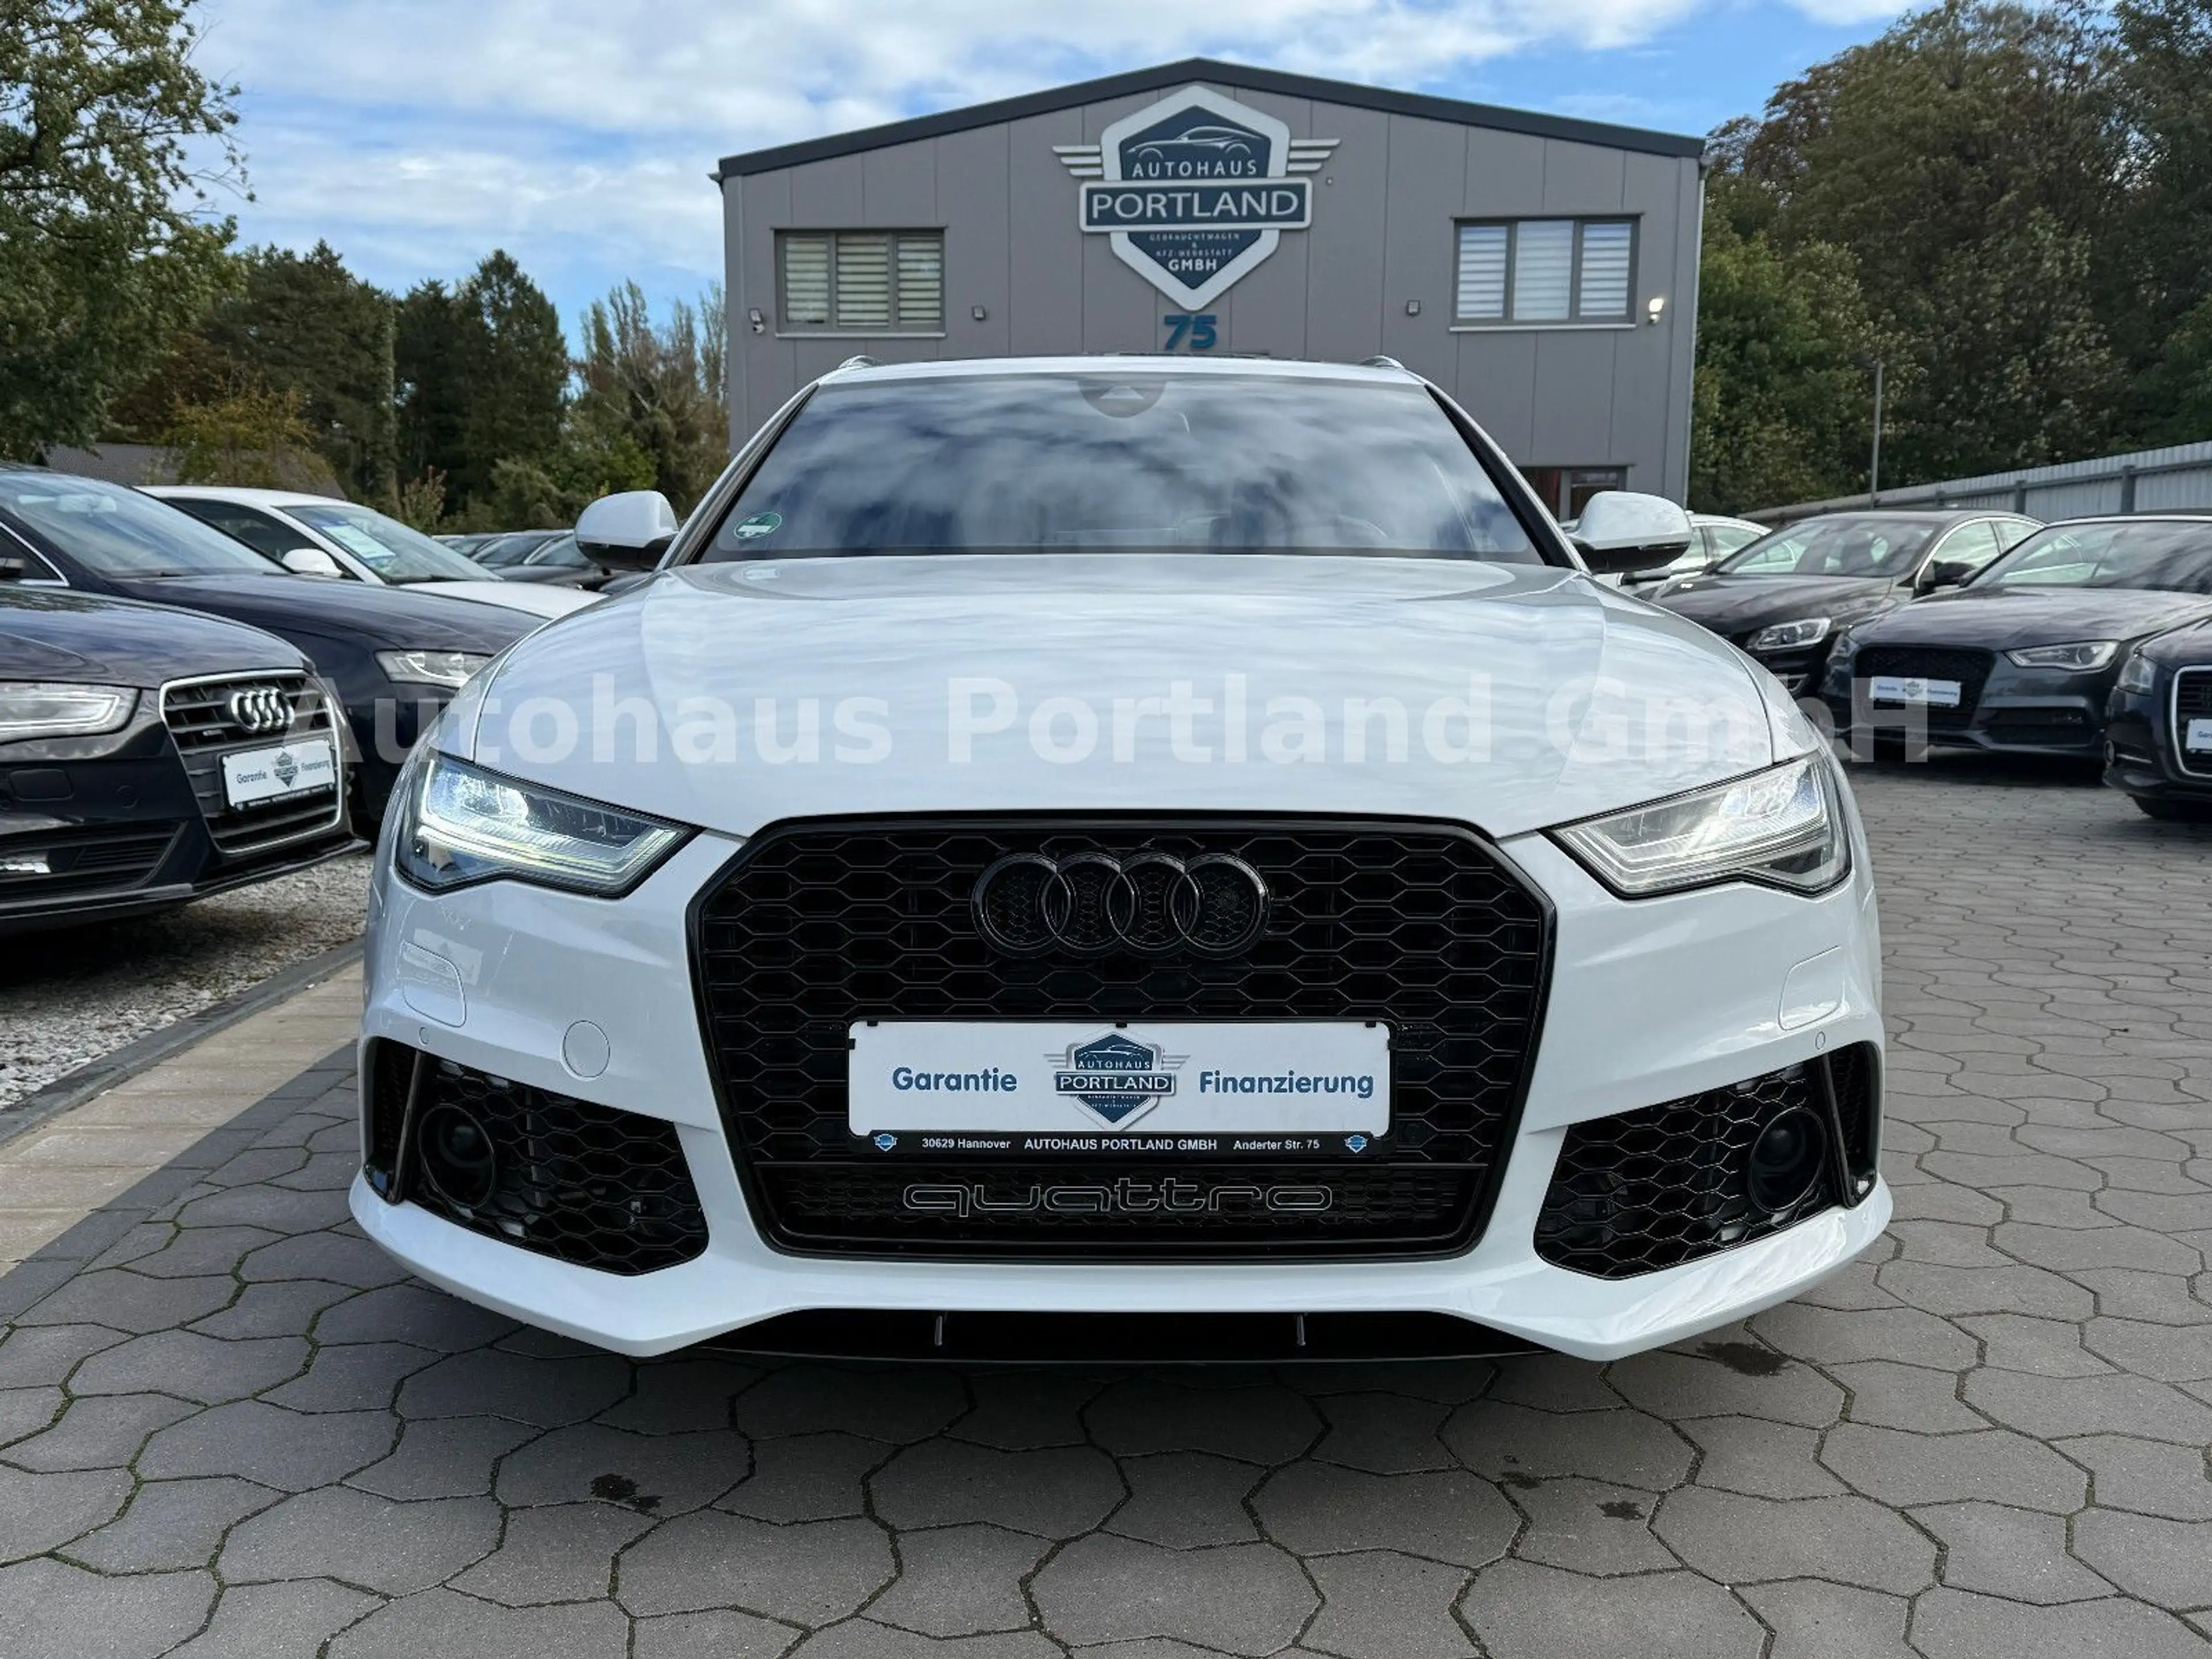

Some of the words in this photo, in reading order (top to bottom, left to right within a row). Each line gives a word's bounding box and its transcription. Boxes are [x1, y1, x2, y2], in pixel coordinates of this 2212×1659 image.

[1131, 159, 1257, 177] AUTOHAUS
[1092, 190, 1298, 218] PORTLAND
[1168, 259, 1217, 271] GMBH
[1164, 315, 1217, 350] 75
[1078, 1060, 1150, 1069] AUTOHAUS
[892, 1067, 1017, 1092] Garantie
[1060, 1076, 1169, 1089] PORTLAND
[1199, 1070, 1374, 1099] Finanzierung
[922, 1138, 955, 1149] 30629
[958, 1138, 1011, 1149] Hannover
[1024, 1138, 1097, 1150] AUTOHAUS
[1101, 1138, 1173, 1150] PORTLAND
[1177, 1139, 1218, 1150] GMBH
[1233, 1139, 1281, 1150] Anderter
[1285, 1139, 1303, 1150] Str.
[1306, 1139, 1320, 1150] 75
[903, 1177, 1332, 1217] quattro
